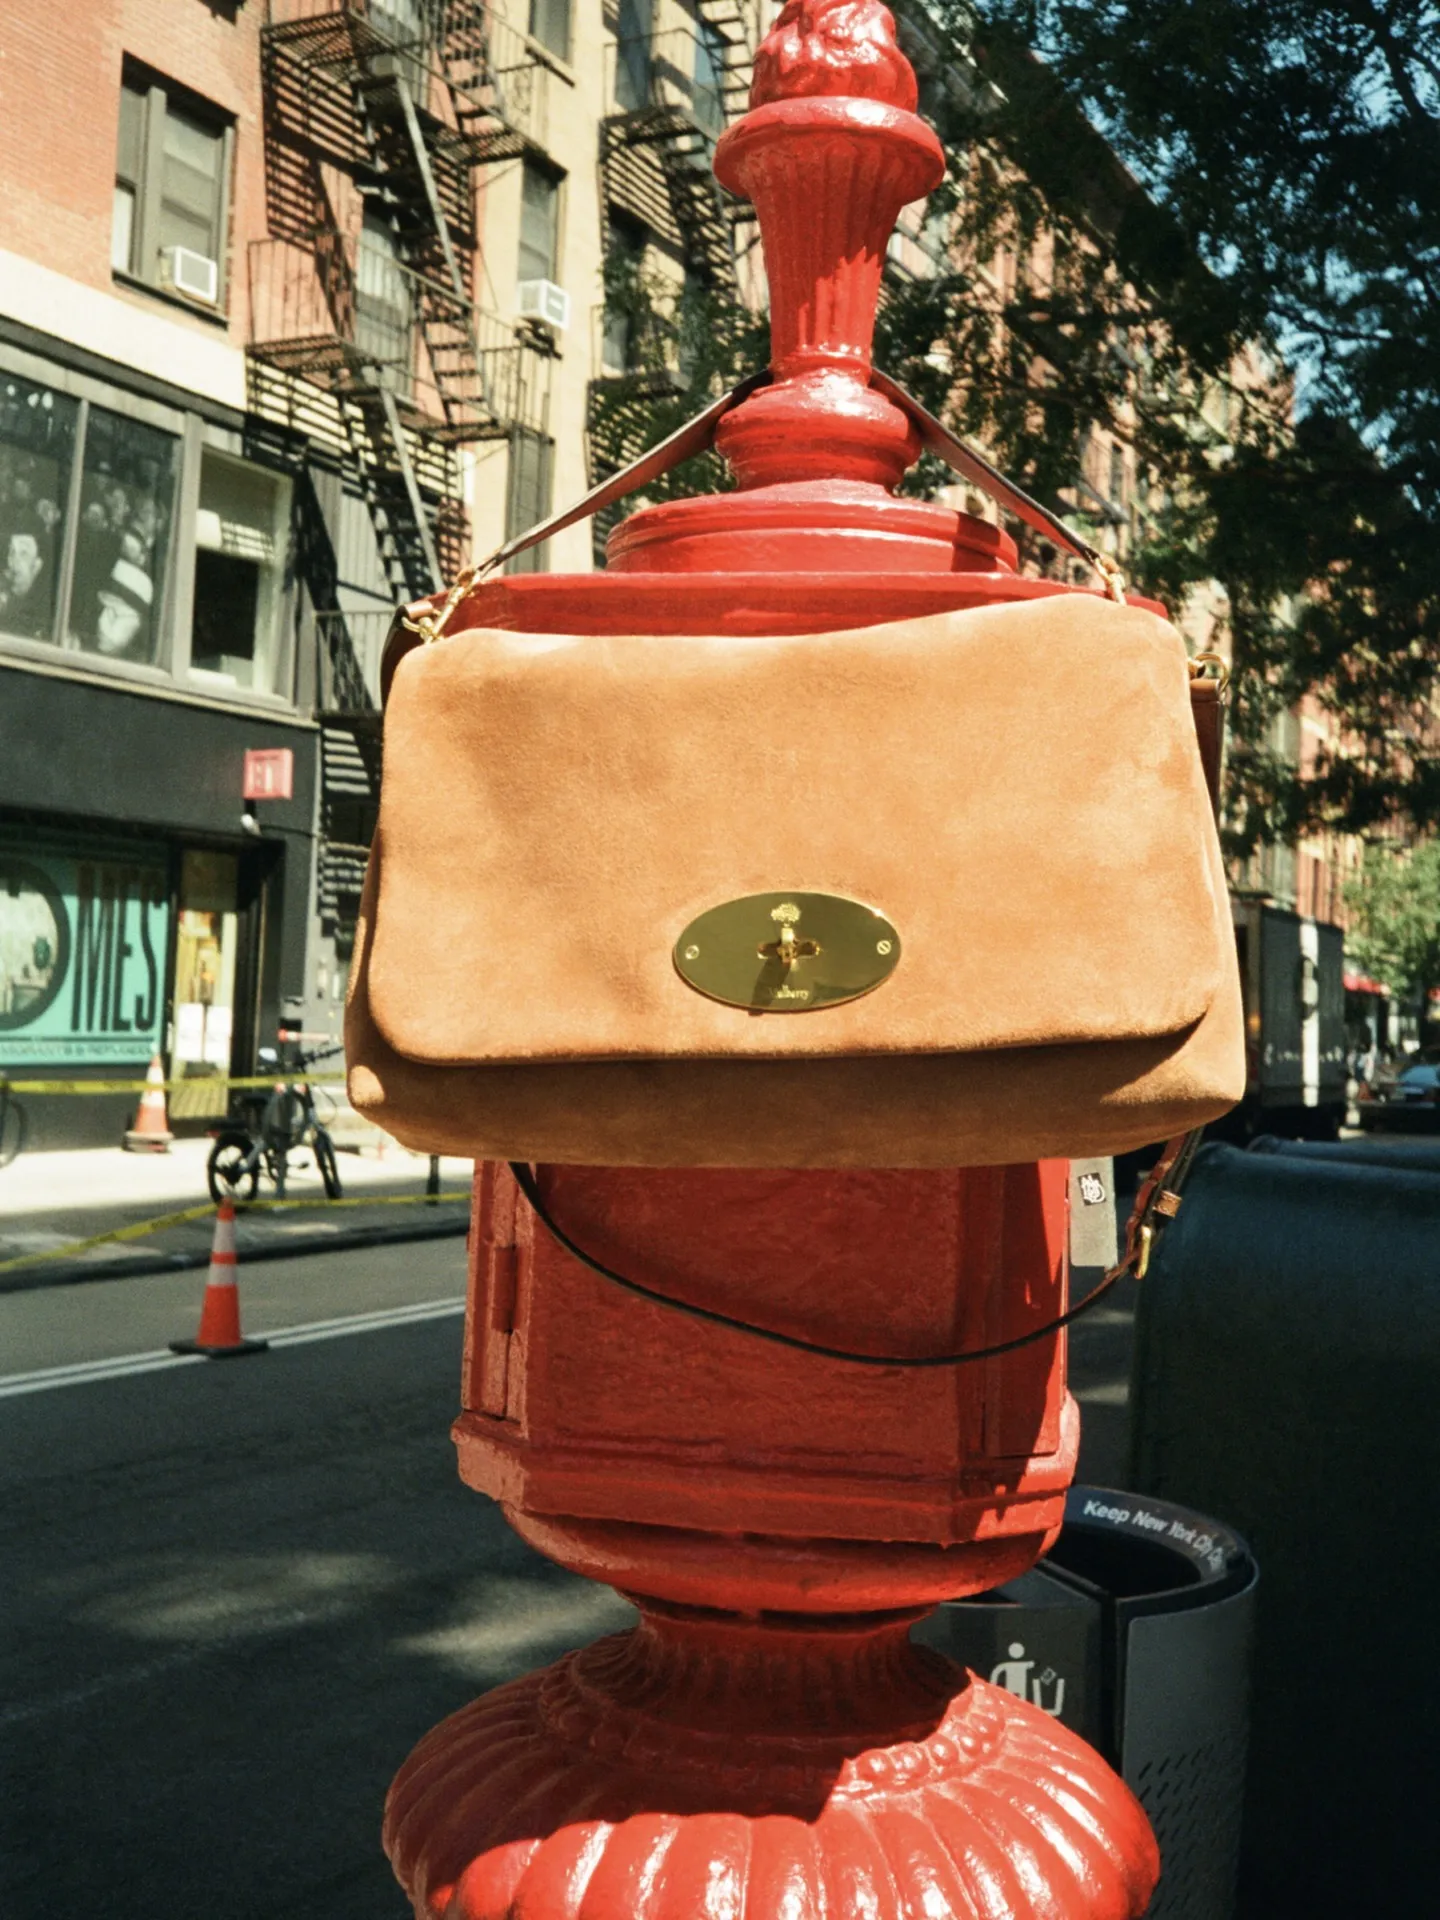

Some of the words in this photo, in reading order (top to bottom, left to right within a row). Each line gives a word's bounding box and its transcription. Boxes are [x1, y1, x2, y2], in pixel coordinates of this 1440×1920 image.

[1083, 1500, 1130, 1524] Keep
[1132, 1510, 1168, 1532] New
[1168, 1520, 1197, 1544] York
